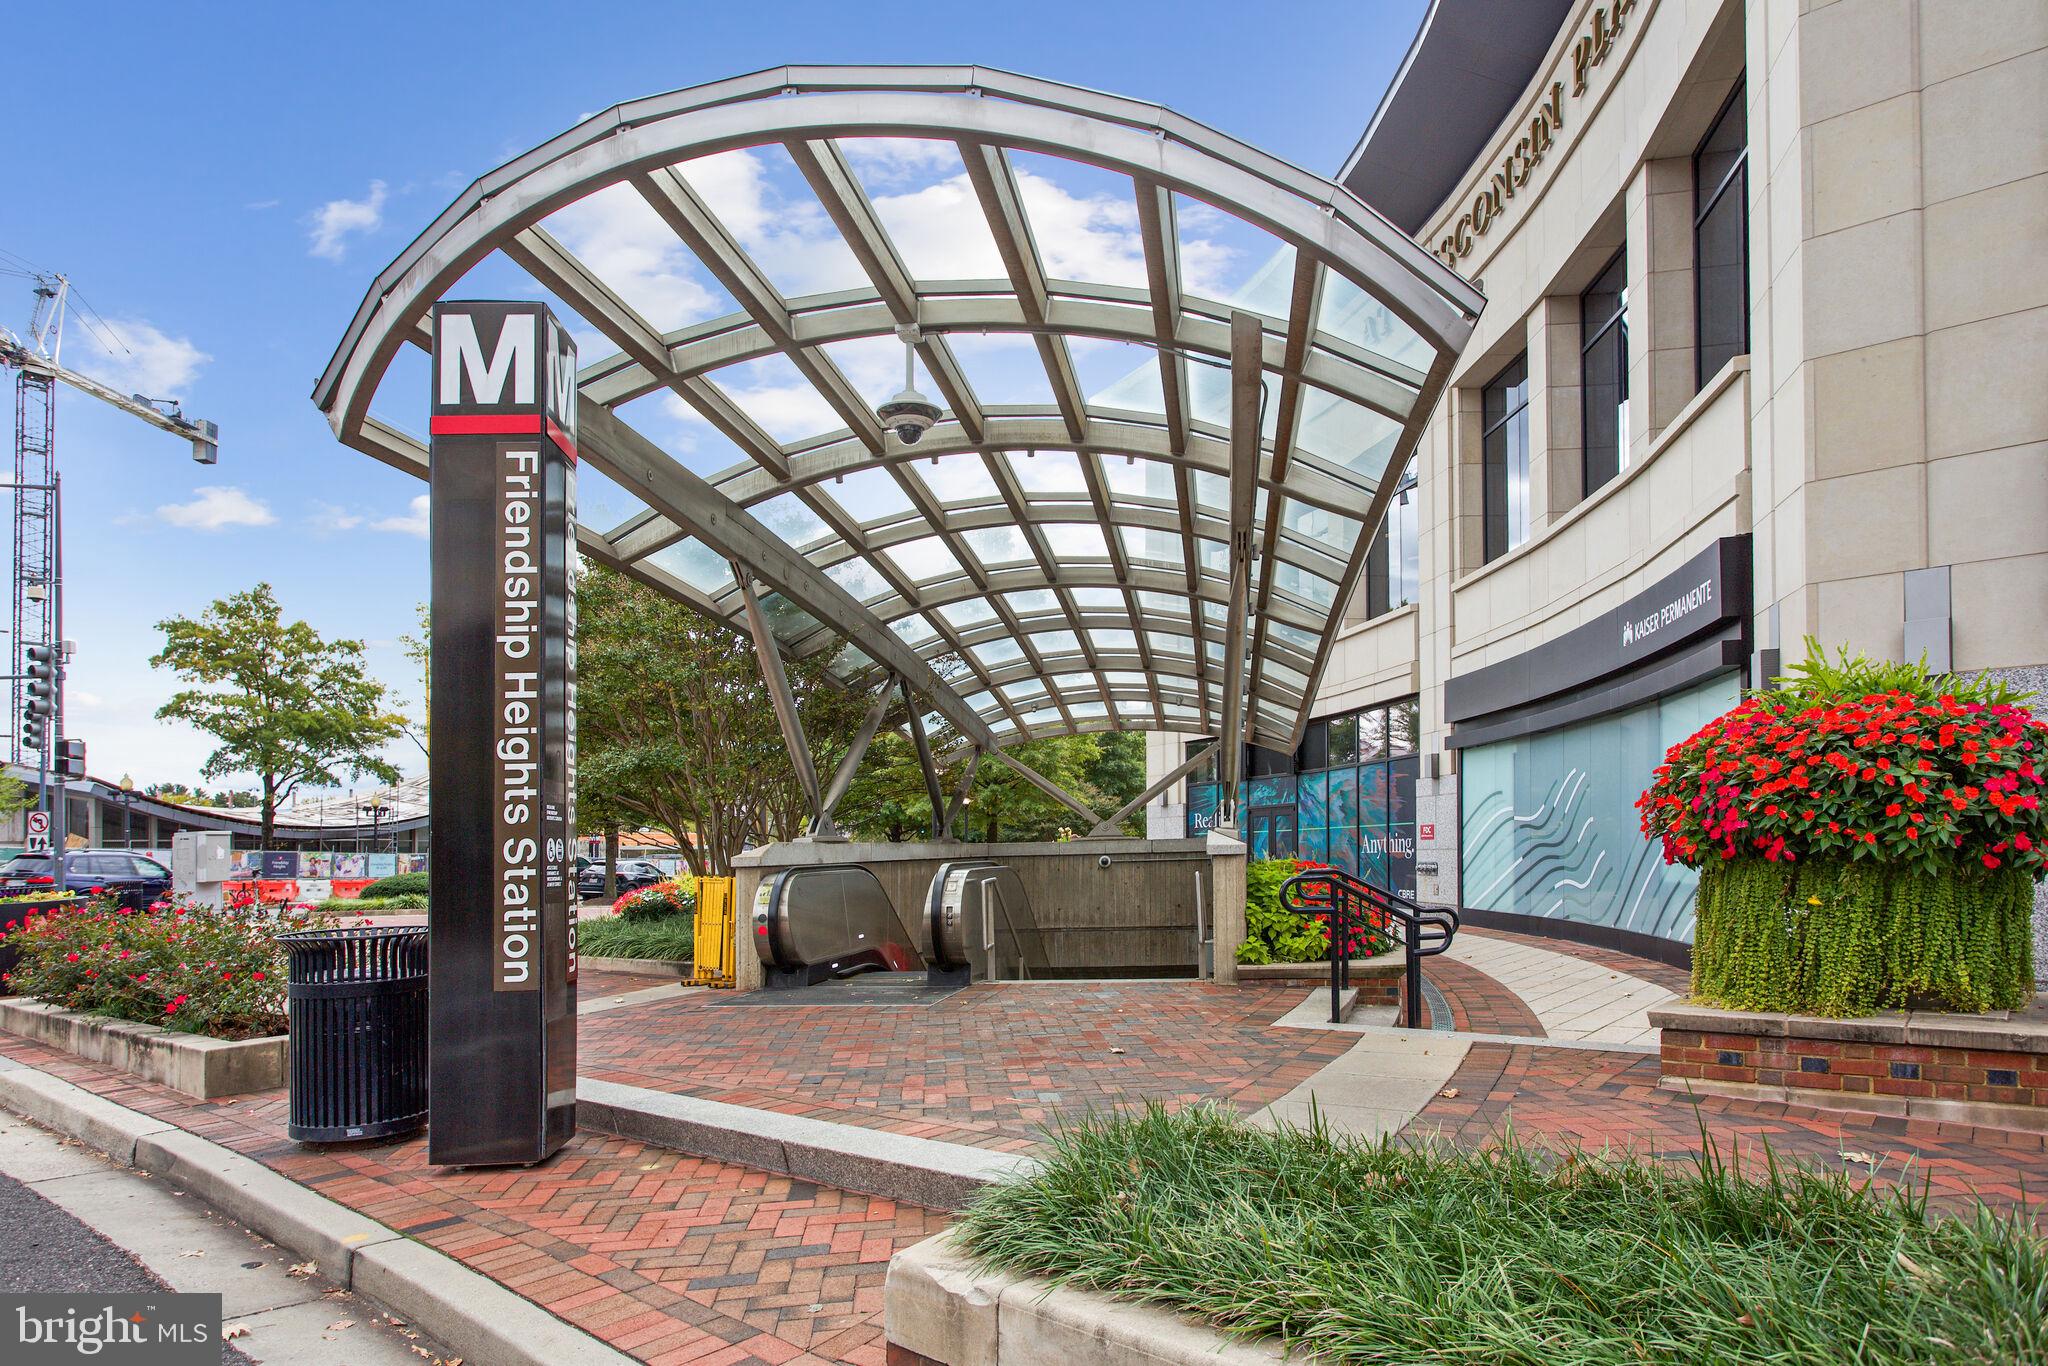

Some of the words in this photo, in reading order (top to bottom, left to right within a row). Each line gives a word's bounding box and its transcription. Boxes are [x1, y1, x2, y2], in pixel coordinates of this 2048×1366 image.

[1433, 82, 1565, 270] SCONSIN
[439, 314, 536, 404] M
[546, 315, 576, 436] M
[496, 450, 539, 660] Friendship
[1634, 612, 1659, 641] KAISER
[1660, 579, 1712, 628] PERMANENTE
[496, 672, 538, 825] Heights
[566, 681, 577, 826] Heights
[502, 838, 537, 984] Station
[567, 837, 578, 973] Station
[1361, 832, 1415, 859] Anything.
[1397, 889, 1415, 900] CBRE
